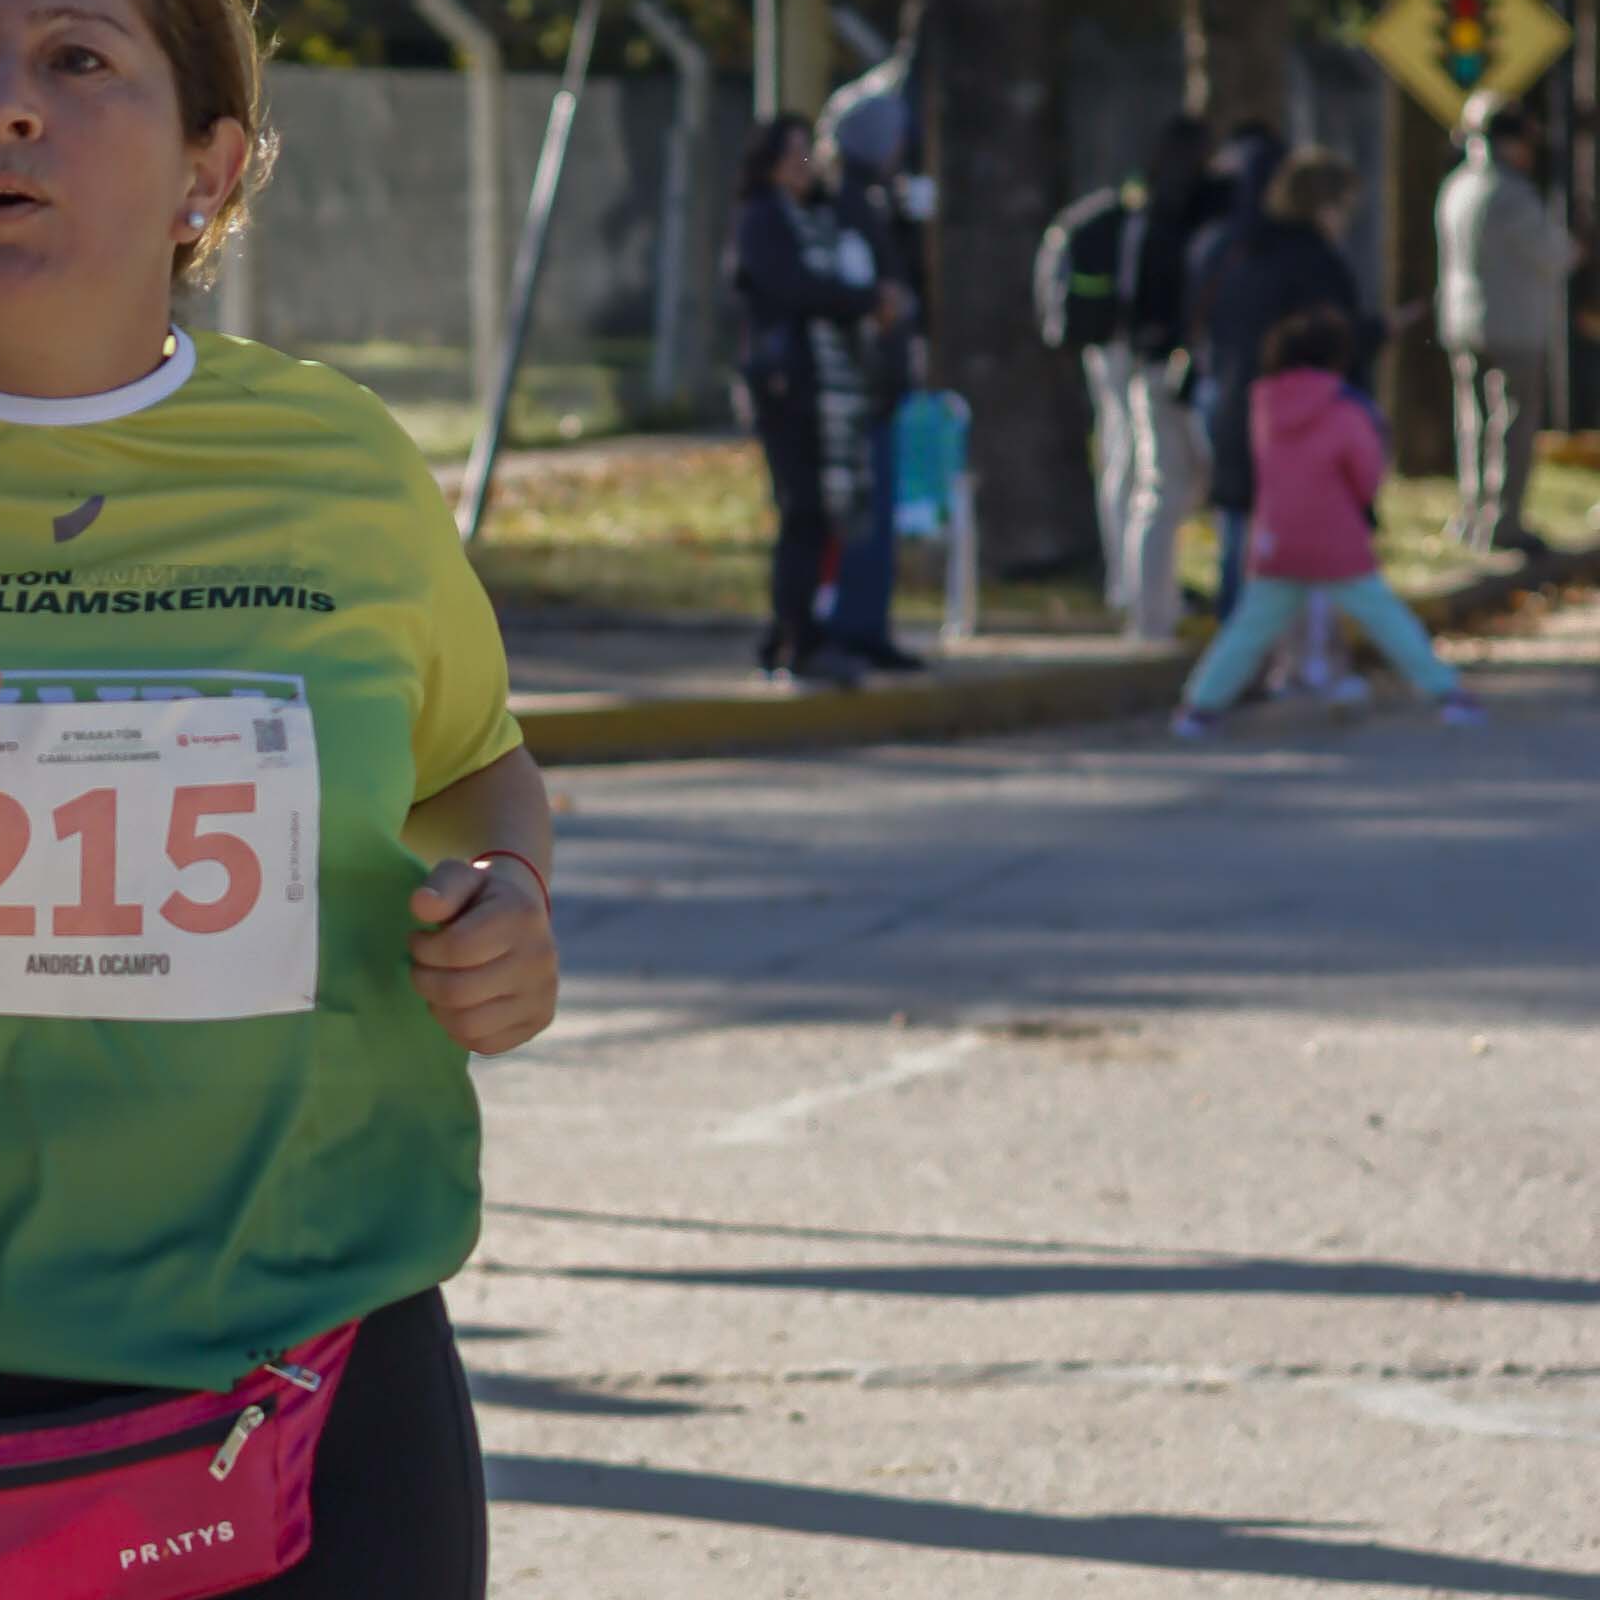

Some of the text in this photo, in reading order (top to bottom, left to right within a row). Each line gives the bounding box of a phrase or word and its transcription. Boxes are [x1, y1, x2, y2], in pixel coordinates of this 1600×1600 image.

[25, 953, 171, 976] ANDREA OCAMPO
[119, 1520, 235, 1570] PRATYS
